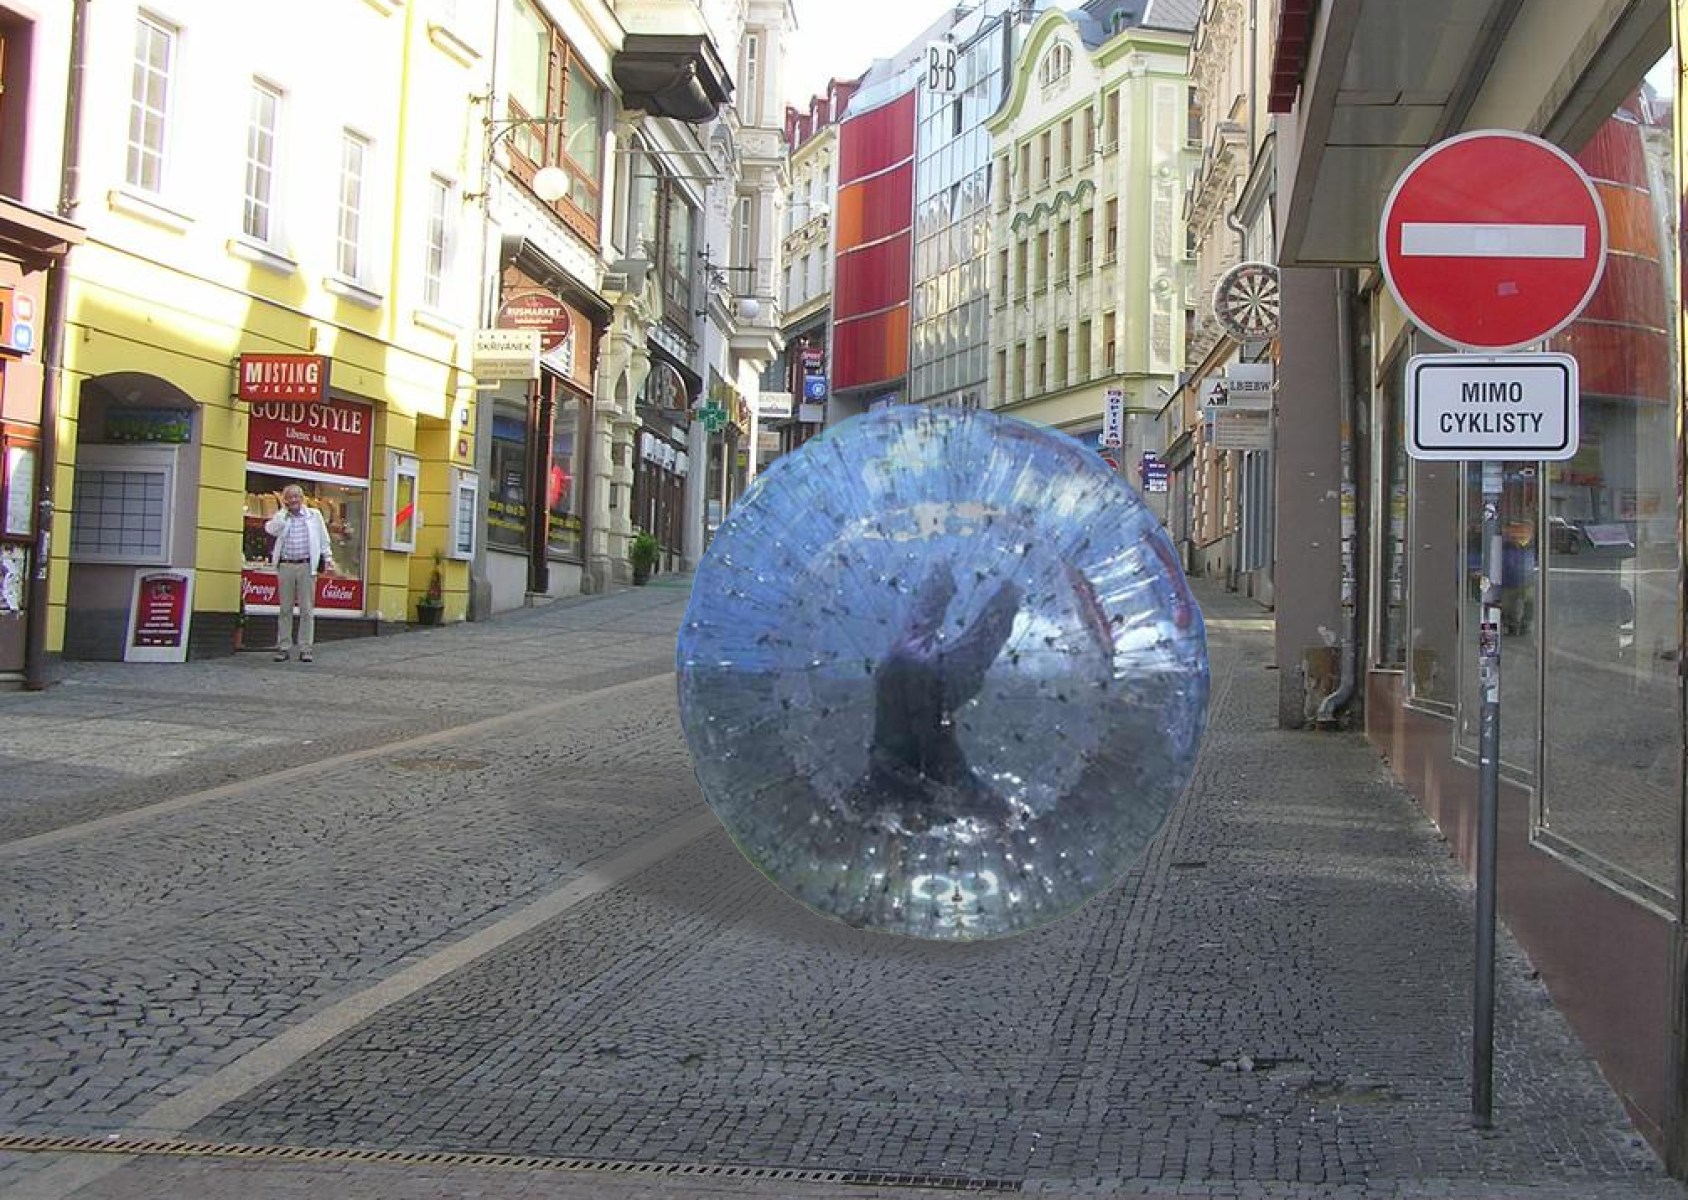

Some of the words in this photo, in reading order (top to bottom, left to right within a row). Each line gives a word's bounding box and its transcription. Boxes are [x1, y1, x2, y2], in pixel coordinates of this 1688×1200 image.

[930, 46, 956, 91] B+B
[246, 361, 318, 384] MUSTANG
[263, 385, 318, 393] JEANS
[1461, 381, 1523, 403] MIMO
[250, 402, 306, 423] GOLD
[309, 402, 362, 435] STYLE
[1109, 398, 1120, 438] OPTIKA
[1440, 411, 1543, 433] CYKLISTY
[263, 440, 345, 470] ZLATNICTVÍ
